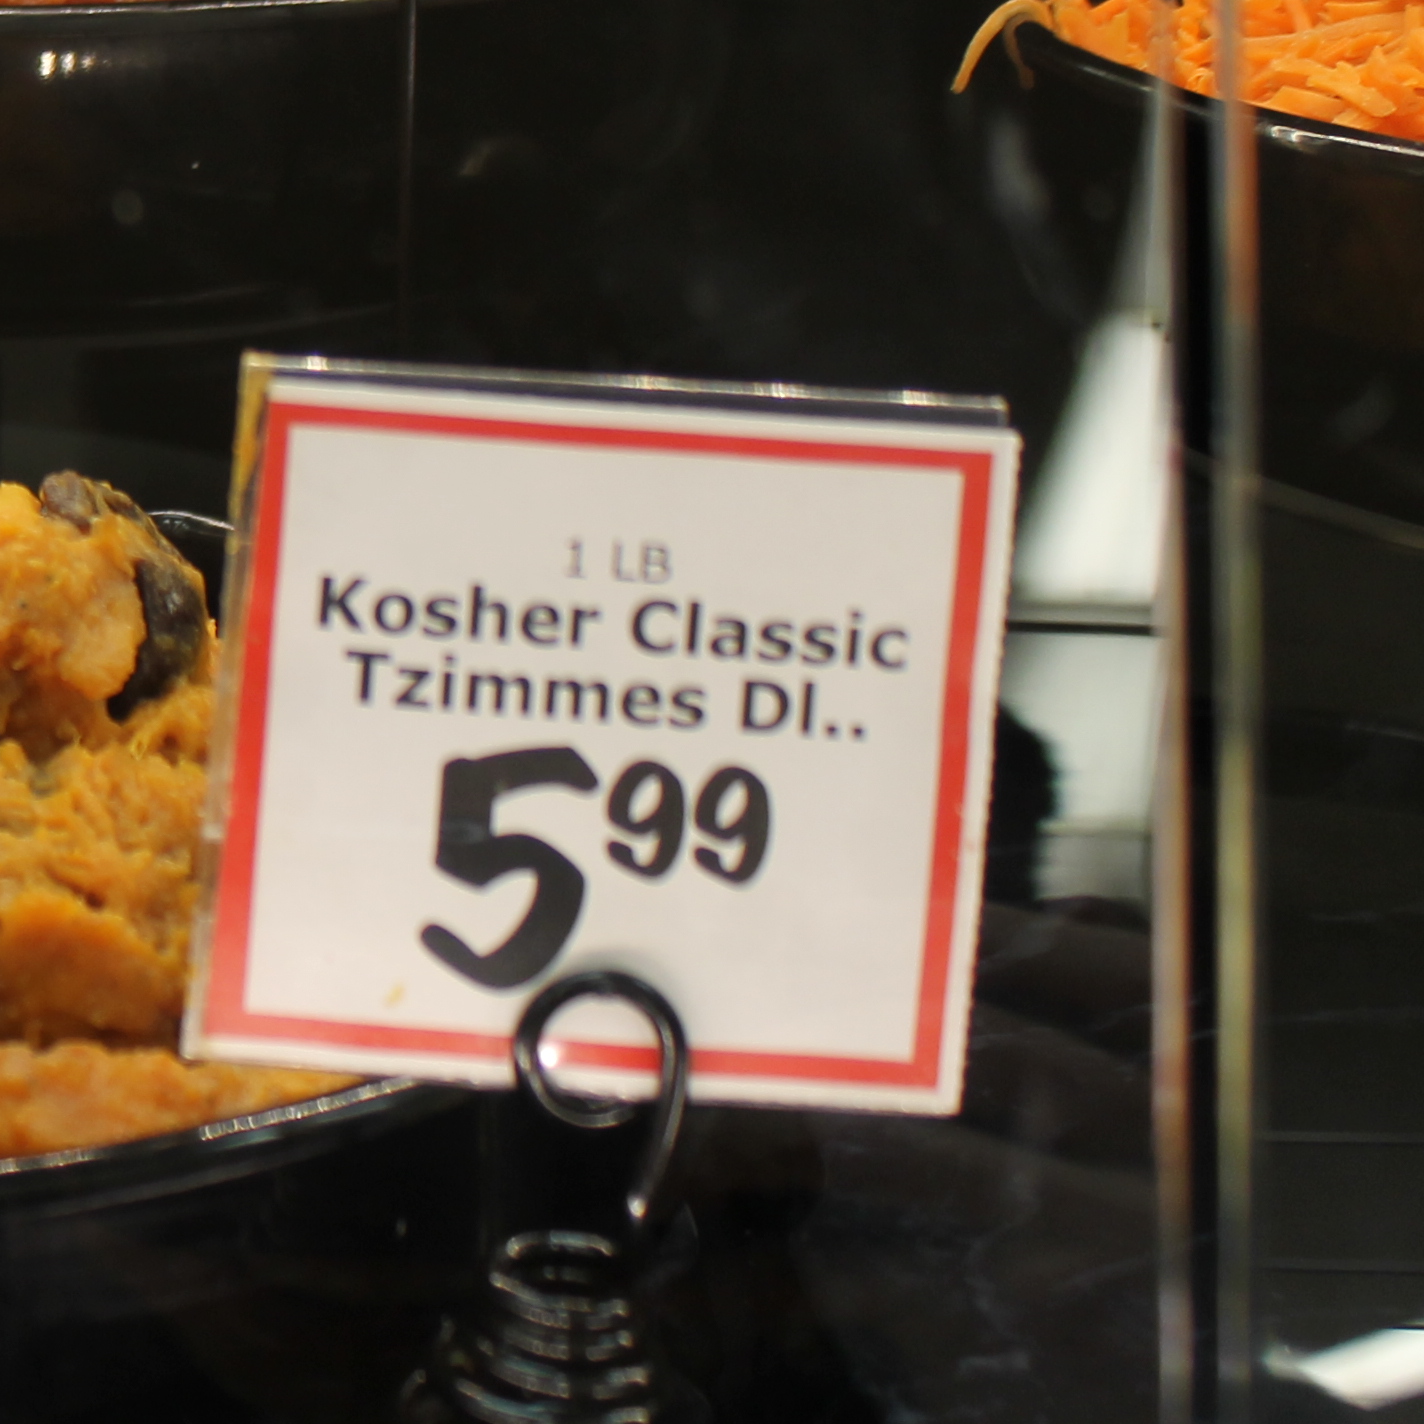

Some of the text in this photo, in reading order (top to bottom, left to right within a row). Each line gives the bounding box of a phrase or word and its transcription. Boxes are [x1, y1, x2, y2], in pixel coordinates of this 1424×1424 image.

[562, 537, 672, 584] 1 LB
[315, 577, 910, 672] Kosher Classic
[345, 651, 708, 730] Tzimmes
